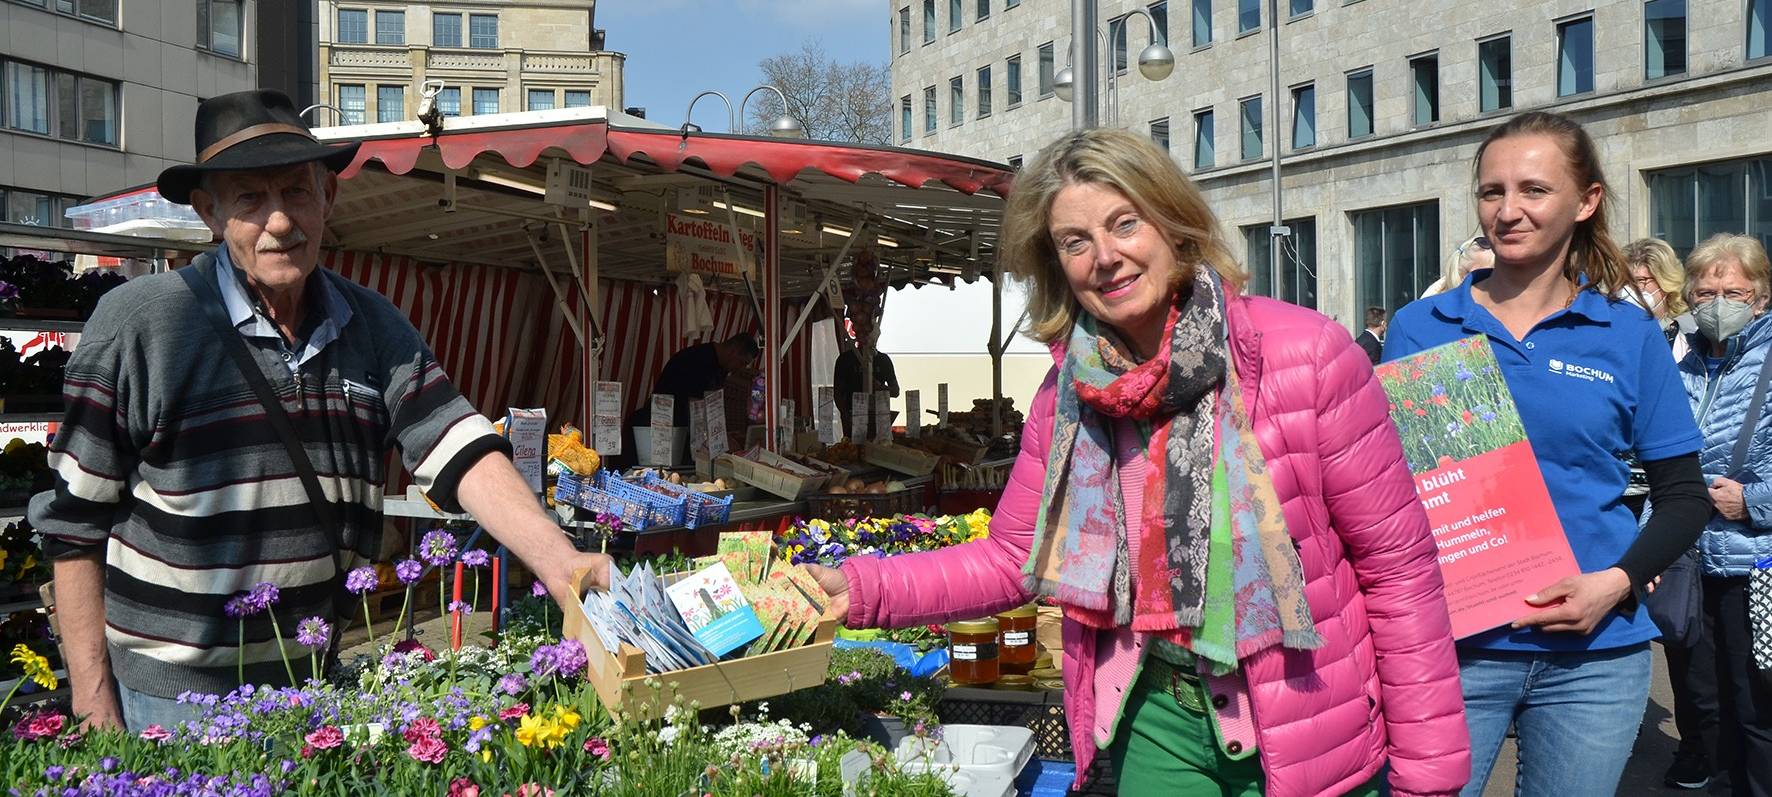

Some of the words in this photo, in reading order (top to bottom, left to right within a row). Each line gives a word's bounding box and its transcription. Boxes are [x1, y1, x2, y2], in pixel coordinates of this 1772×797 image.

[668, 215, 729, 242] Kartoffeln
[732, 229, 753, 251] ieg
[691, 253, 733, 273] Bochum
[1566, 364, 1614, 383] BOCHUM
[1566, 371, 1595, 381] Marketing
[1422, 468, 1466, 491] blüht
[1432, 525, 1450, 537] mit
[1451, 517, 1471, 530] und
[1472, 507, 1506, 523] helfen
[1436, 528, 1490, 549] Hummeln,
[1468, 541, 1489, 555] und
[1490, 535, 1508, 547] Co!
